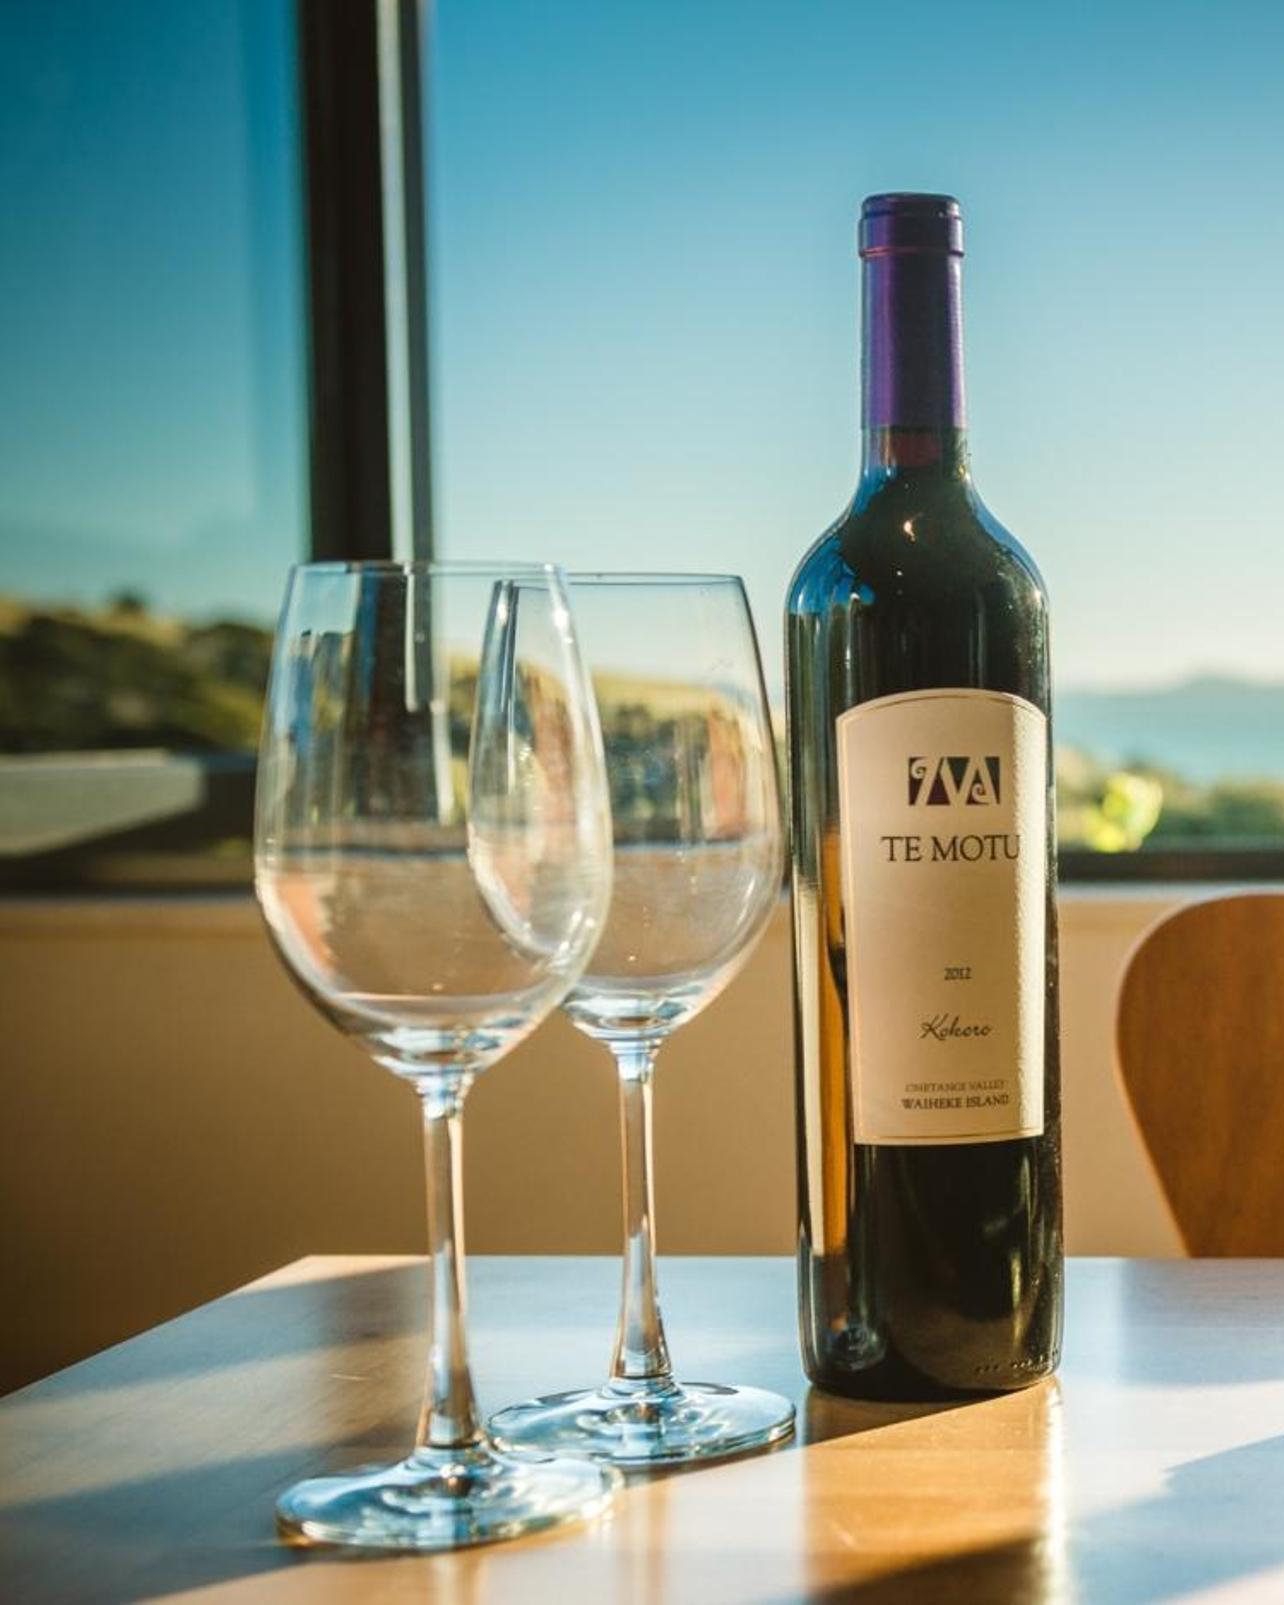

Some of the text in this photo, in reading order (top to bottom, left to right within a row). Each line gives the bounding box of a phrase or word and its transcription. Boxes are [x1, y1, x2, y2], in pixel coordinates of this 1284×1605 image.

[881, 834, 1021, 862] TE MOTU
[943, 967, 972, 981] 2012
[920, 1013, 993, 1041] Kokoro
[969, 1079, 1005, 1091] VALLEY
[901, 1094, 1009, 1110] WAIHEKE ISLAND
